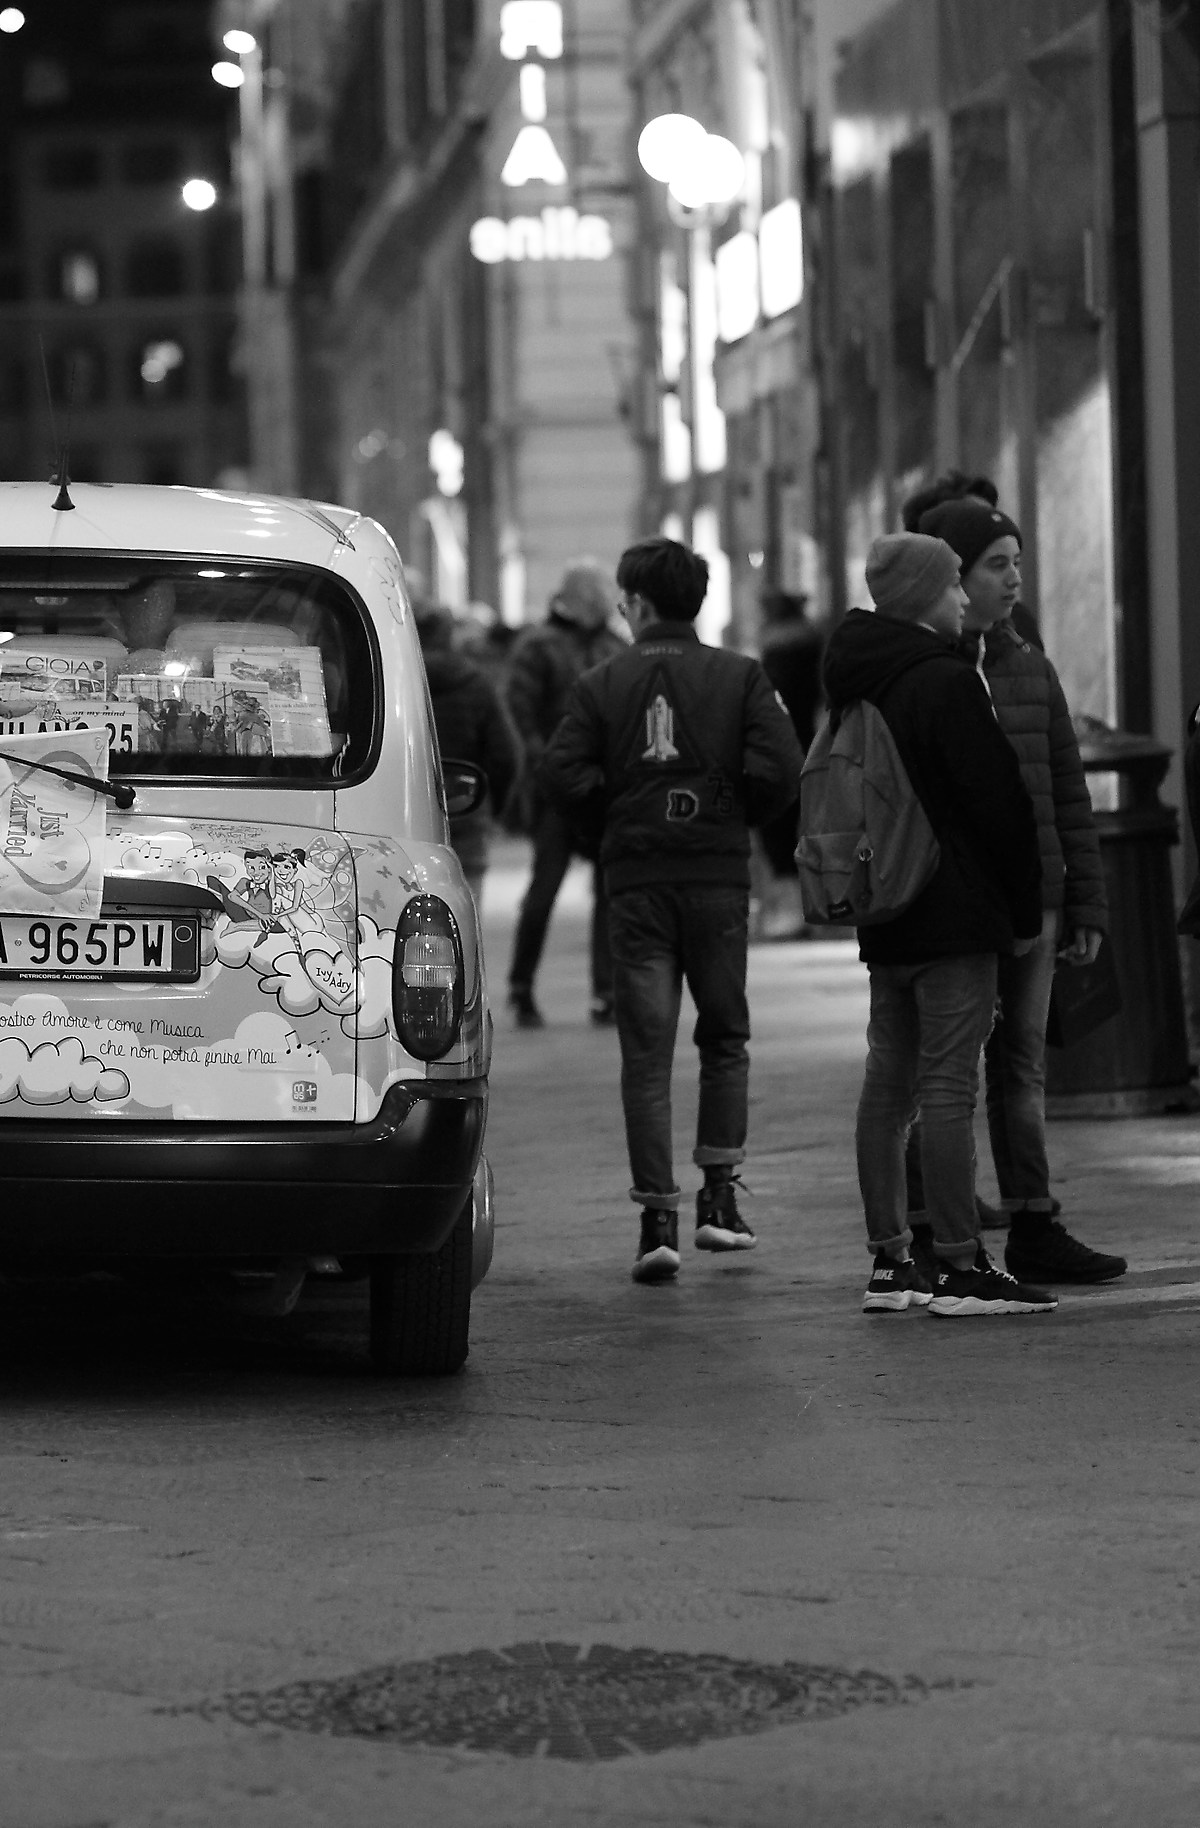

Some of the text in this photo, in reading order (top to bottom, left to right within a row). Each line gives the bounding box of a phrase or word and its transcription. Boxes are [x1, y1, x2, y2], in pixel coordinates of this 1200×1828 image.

[25, 656, 92, 674] GIOIA
[87, 710, 100, 718] my
[667, 788, 699, 821] D
[4, 787, 36, 857] Married
[36, 806, 69, 841] Just
[28, 922, 165, 967] 965PW
[315, 967, 333, 982] Ivy
[329, 976, 352, 994] Adry
[42, 1011, 90, 1029] Amore
[94, 1016, 103, 1029] è
[107, 1019, 145, 1034] come
[100, 1040, 126, 1057] che
[130, 1046, 159, 1060] non
[163, 1046, 200, 1064] potrà
[204, 1051, 243, 1067] finire
